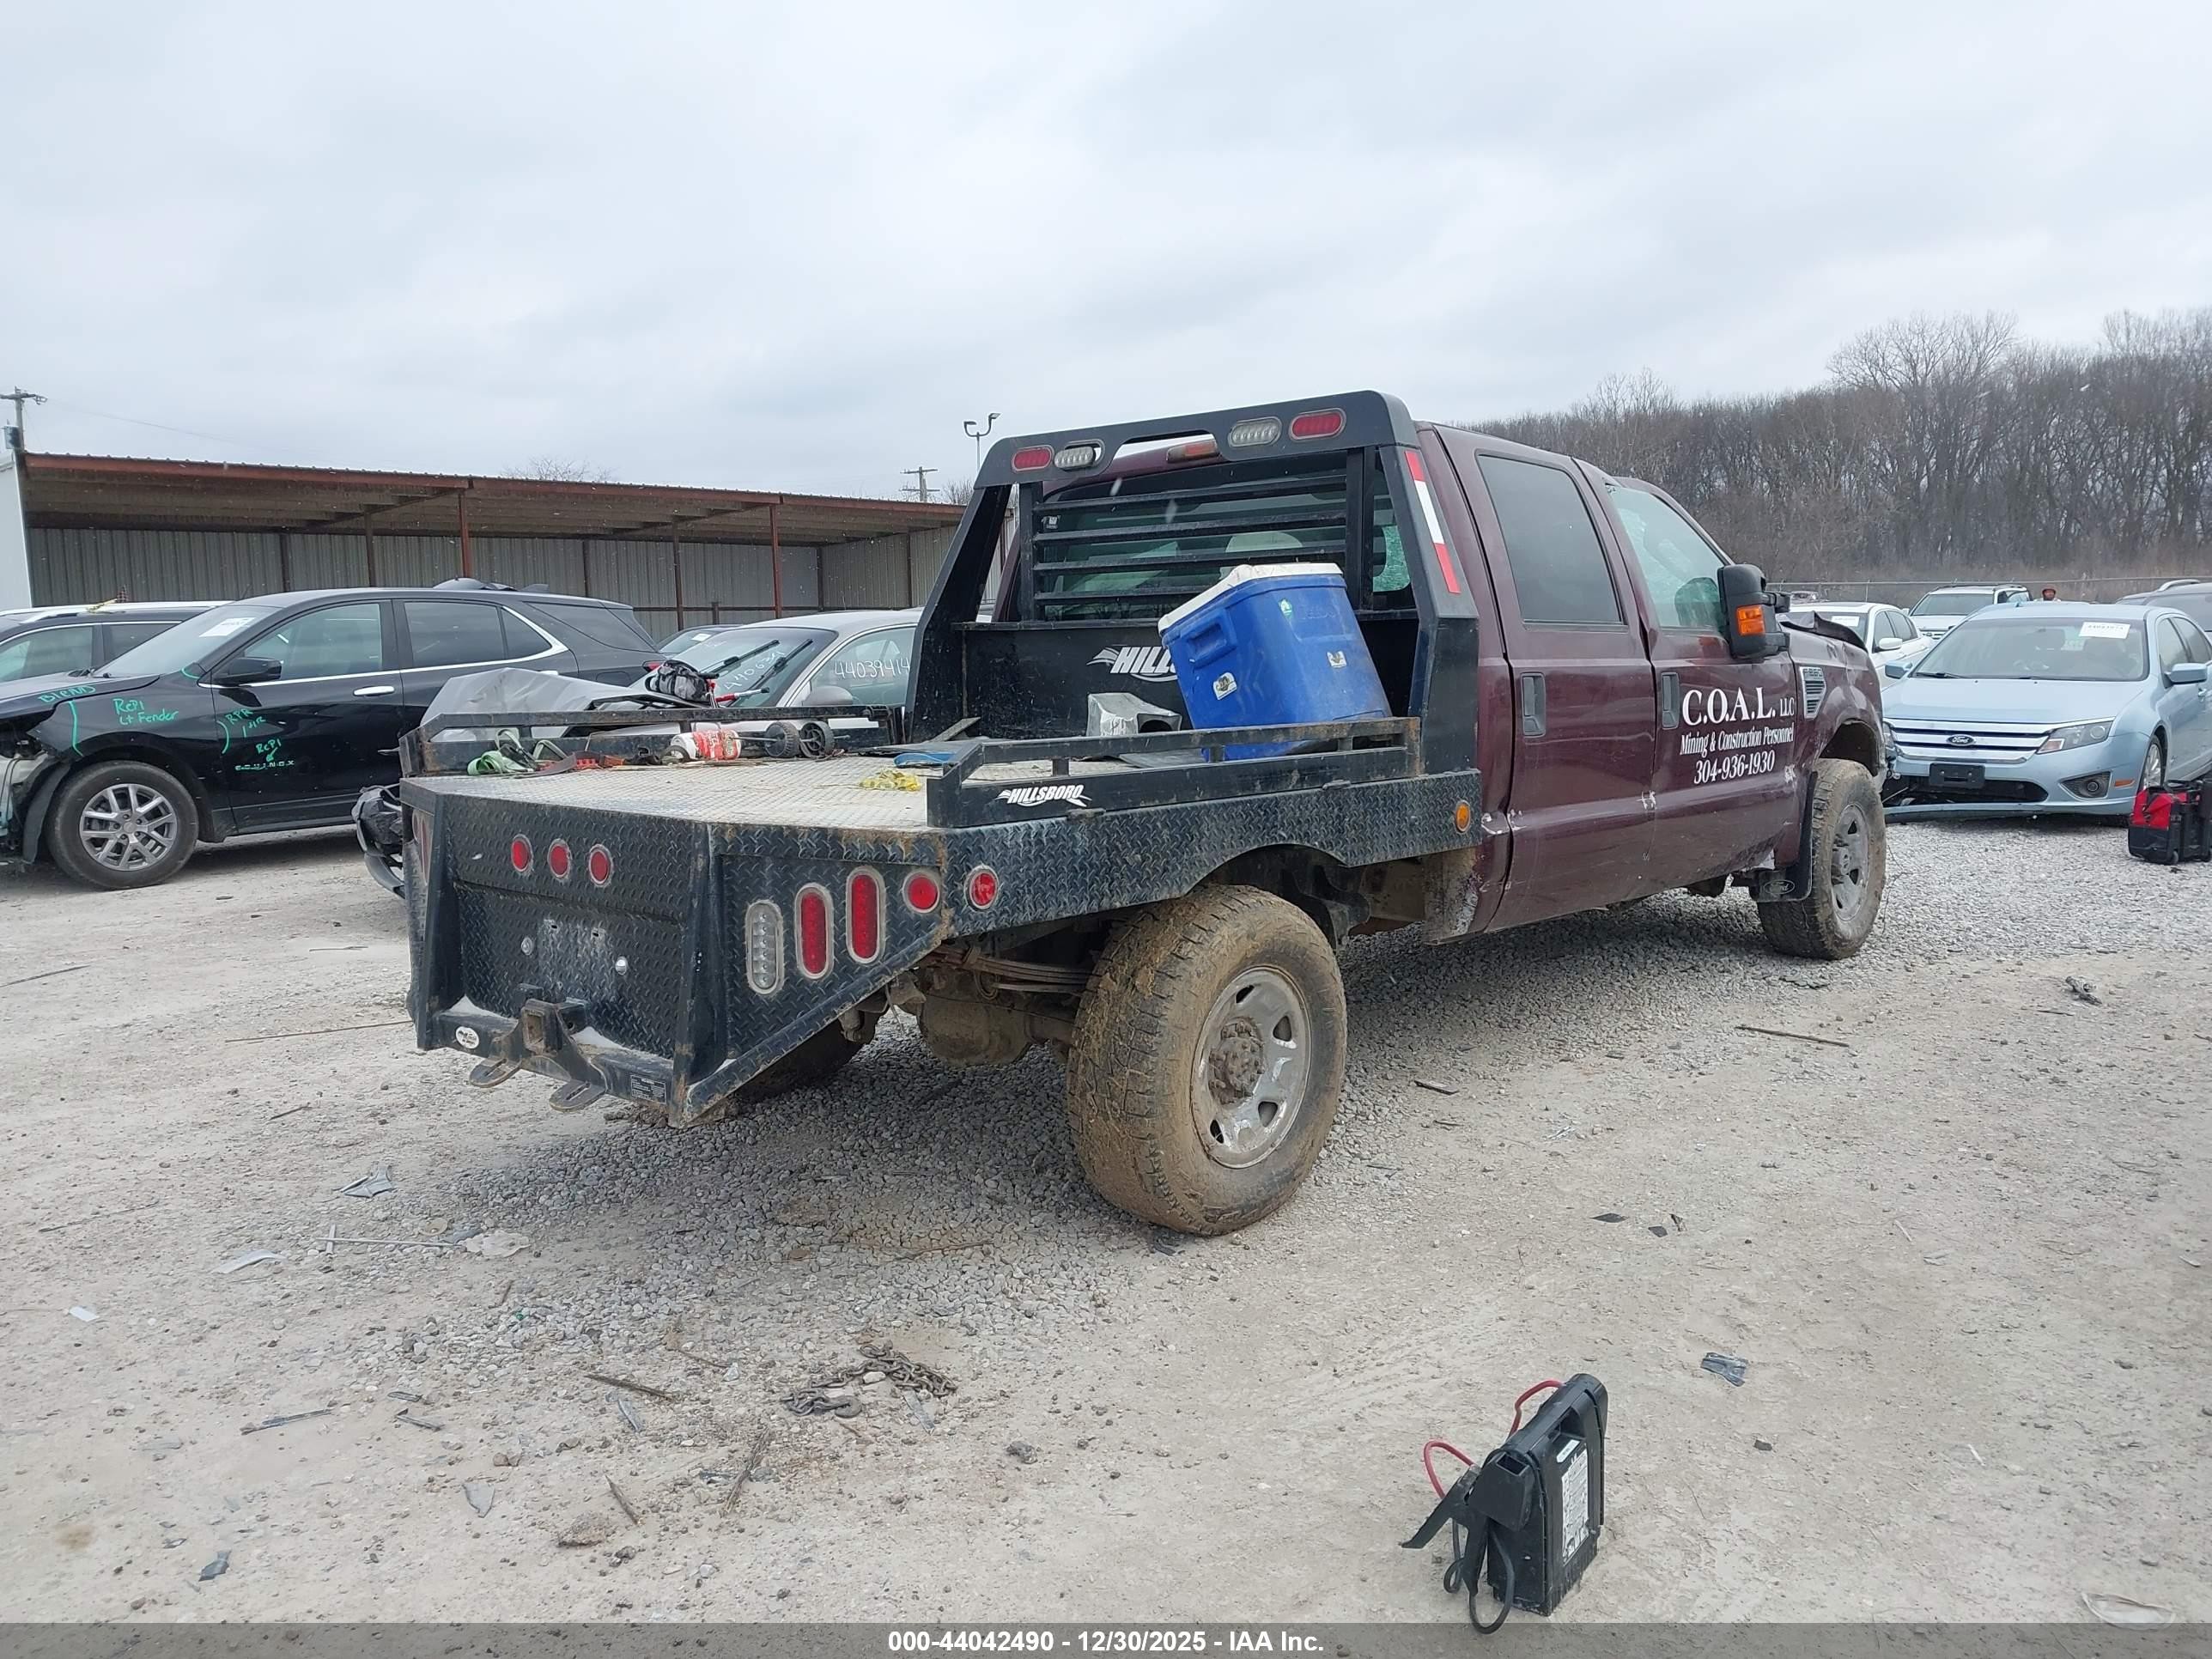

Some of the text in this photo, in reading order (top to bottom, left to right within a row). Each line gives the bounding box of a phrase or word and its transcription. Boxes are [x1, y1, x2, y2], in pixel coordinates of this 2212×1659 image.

[835, 657, 910, 679] 44039414
[1110, 647, 1176, 673] HILL
[137, 708, 179, 724] Fender
[225, 708, 254, 725] RPR
[1683, 687, 1795, 726] C.O.A.L. LLC
[1680, 722, 1795, 758] Mining & Construction Personnel
[1693, 750, 1776, 785] 304-936-1930
[1006, 784, 1085, 804] HILLSBORO
